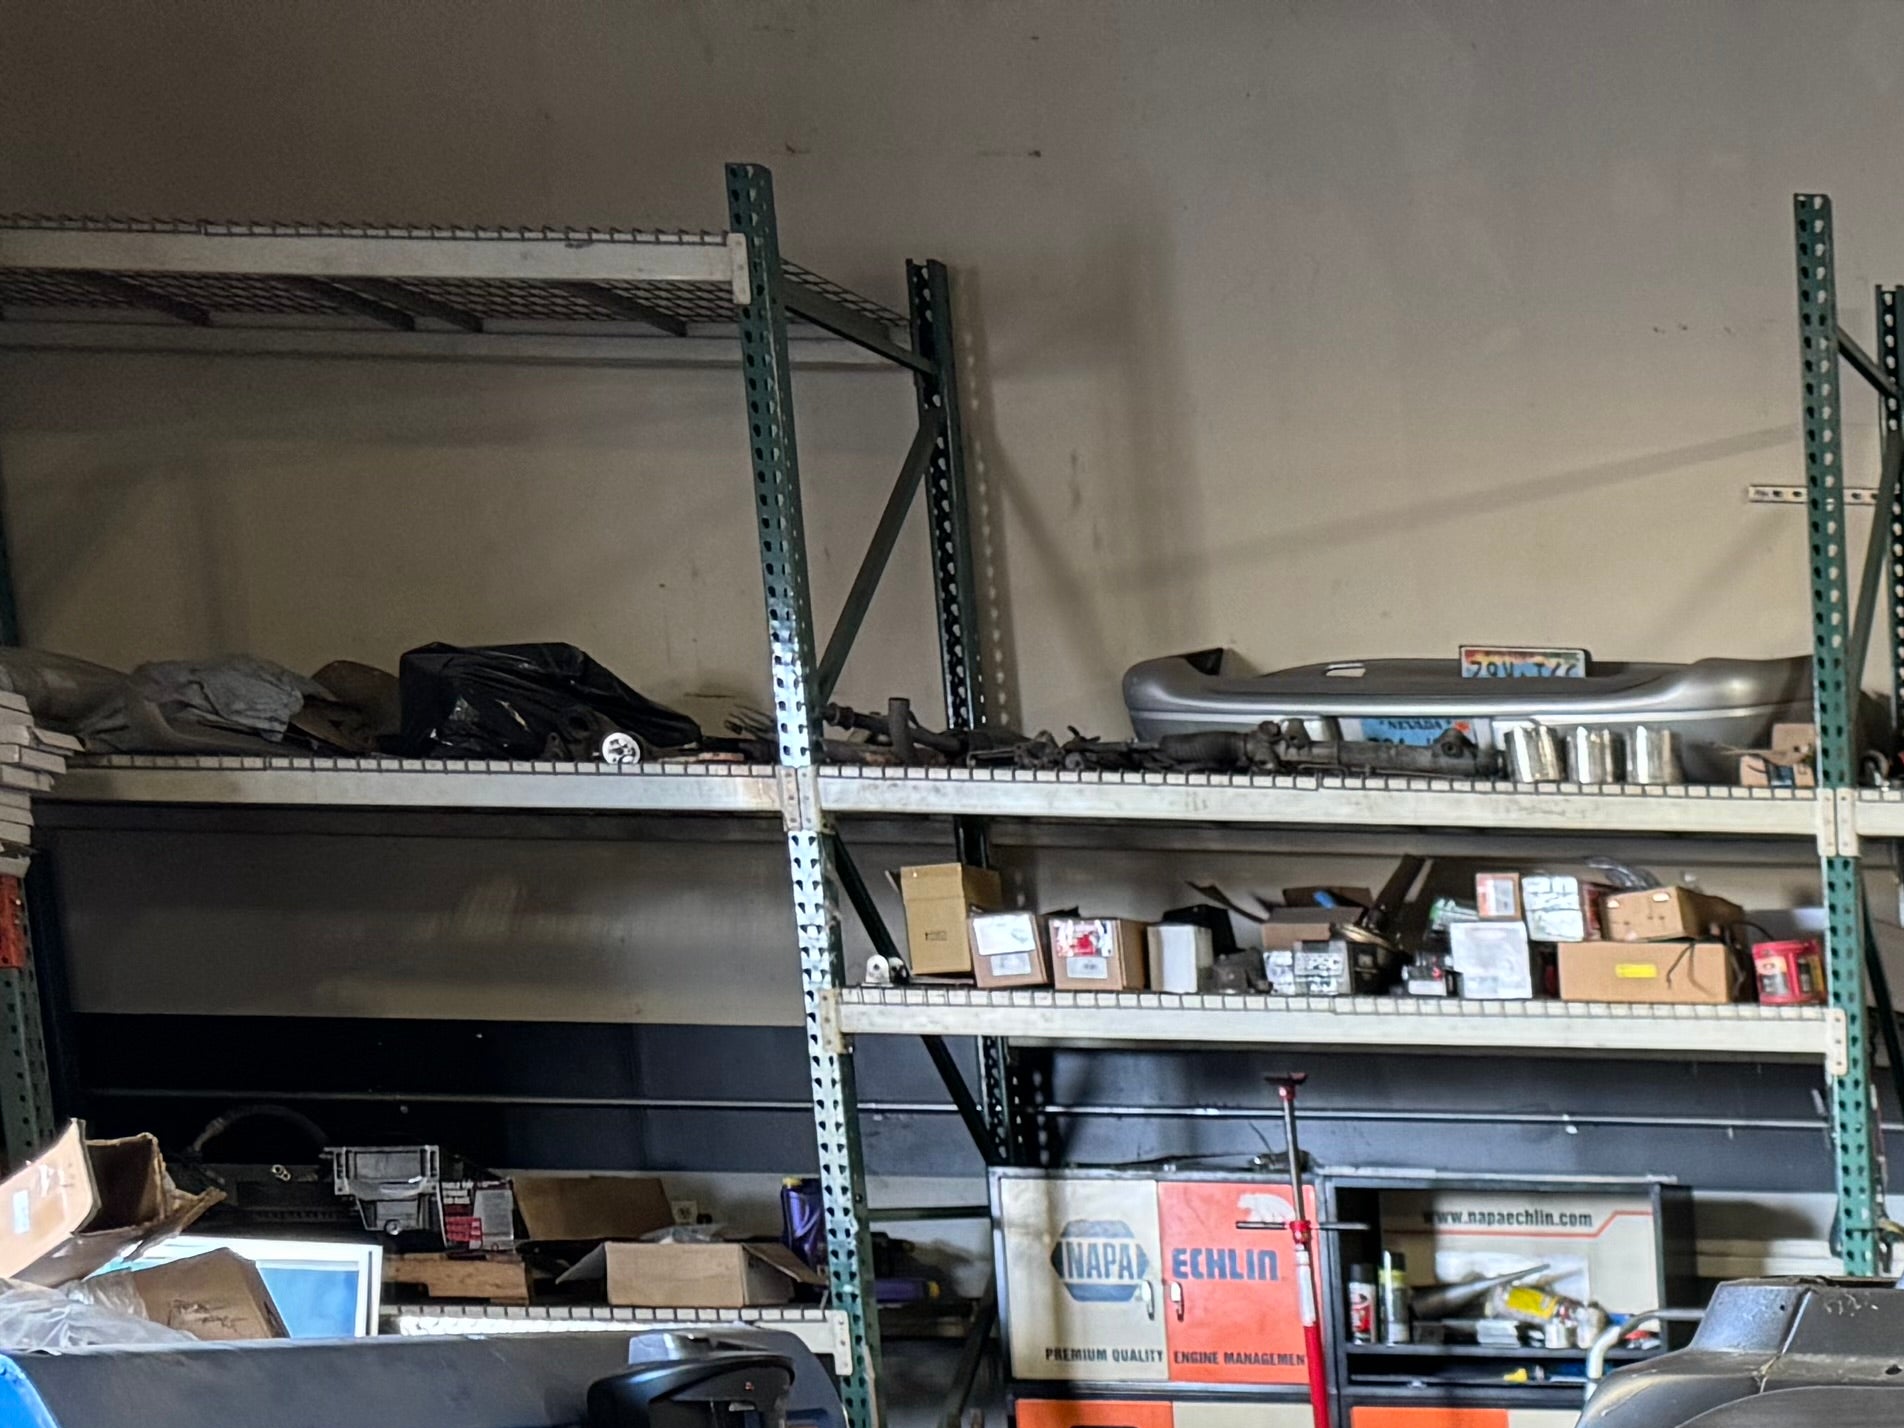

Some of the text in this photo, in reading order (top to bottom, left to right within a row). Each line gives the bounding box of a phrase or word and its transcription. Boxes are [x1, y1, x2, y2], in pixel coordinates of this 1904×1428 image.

[1423, 1208, 1593, 1227] www.napaechlin.com
[1066, 1241, 1135, 1280] NAPA
[1172, 1248, 1279, 1281] ECHLIN
[1045, 1347, 1306, 1366] PREMIUM QUALITY ENGINE MANAGEMEN
